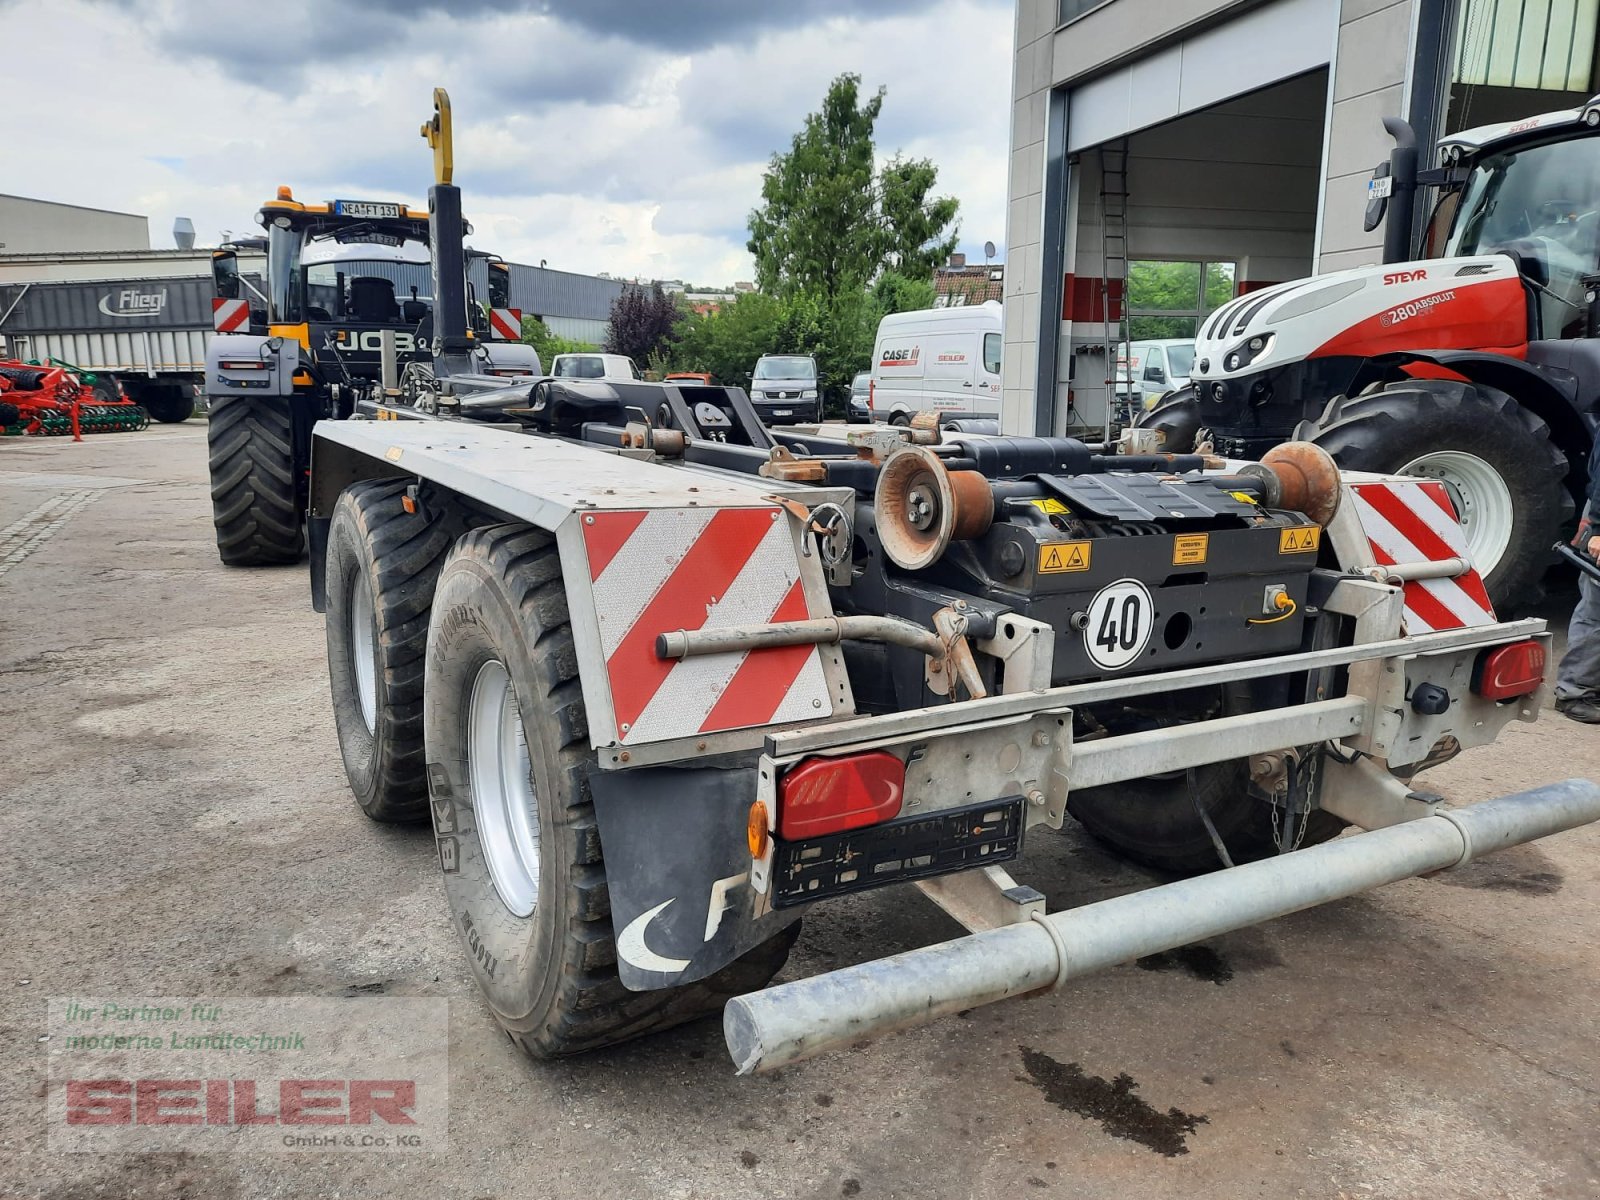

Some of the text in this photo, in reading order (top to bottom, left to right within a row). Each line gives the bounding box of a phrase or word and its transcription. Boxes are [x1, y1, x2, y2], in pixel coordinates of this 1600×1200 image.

[1509, 120, 1537, 133] STEYR
[341, 203, 398, 216] NEA FT 131
[1384, 269, 1428, 285] STEYR
[119, 288, 167, 312] Fliegl
[1415, 291, 1456, 310] ABSOLUT
[882, 349, 910, 361] CASE
[1096, 594, 1140, 653] 40
[427, 764, 456, 872] BKT
